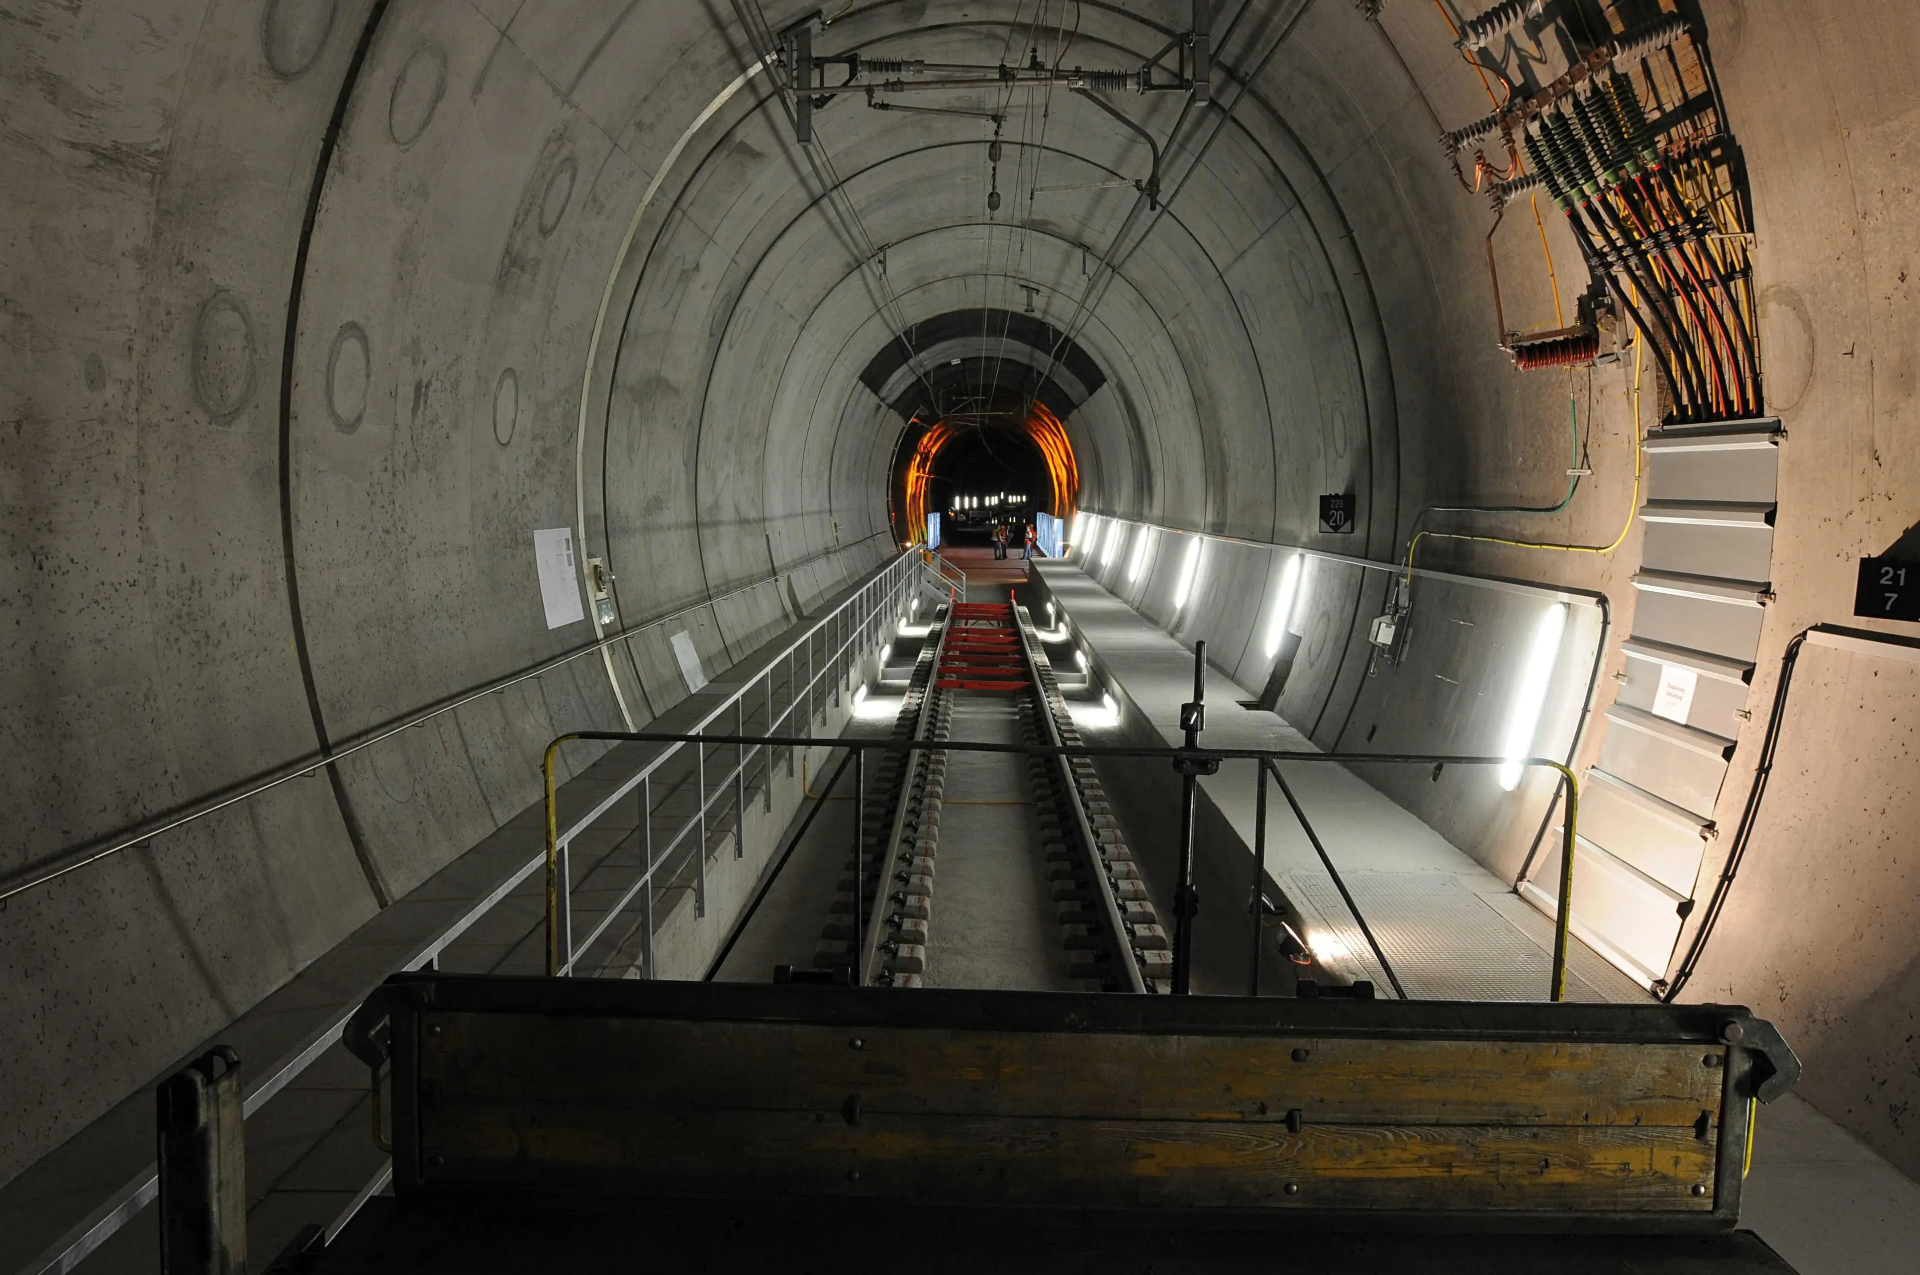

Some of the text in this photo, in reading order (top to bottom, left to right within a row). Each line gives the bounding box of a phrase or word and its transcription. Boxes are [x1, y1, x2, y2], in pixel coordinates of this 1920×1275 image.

[1329, 510, 1344, 526] 20
[1879, 566, 1906, 586] 21
[1884, 593, 1898, 610] 7
